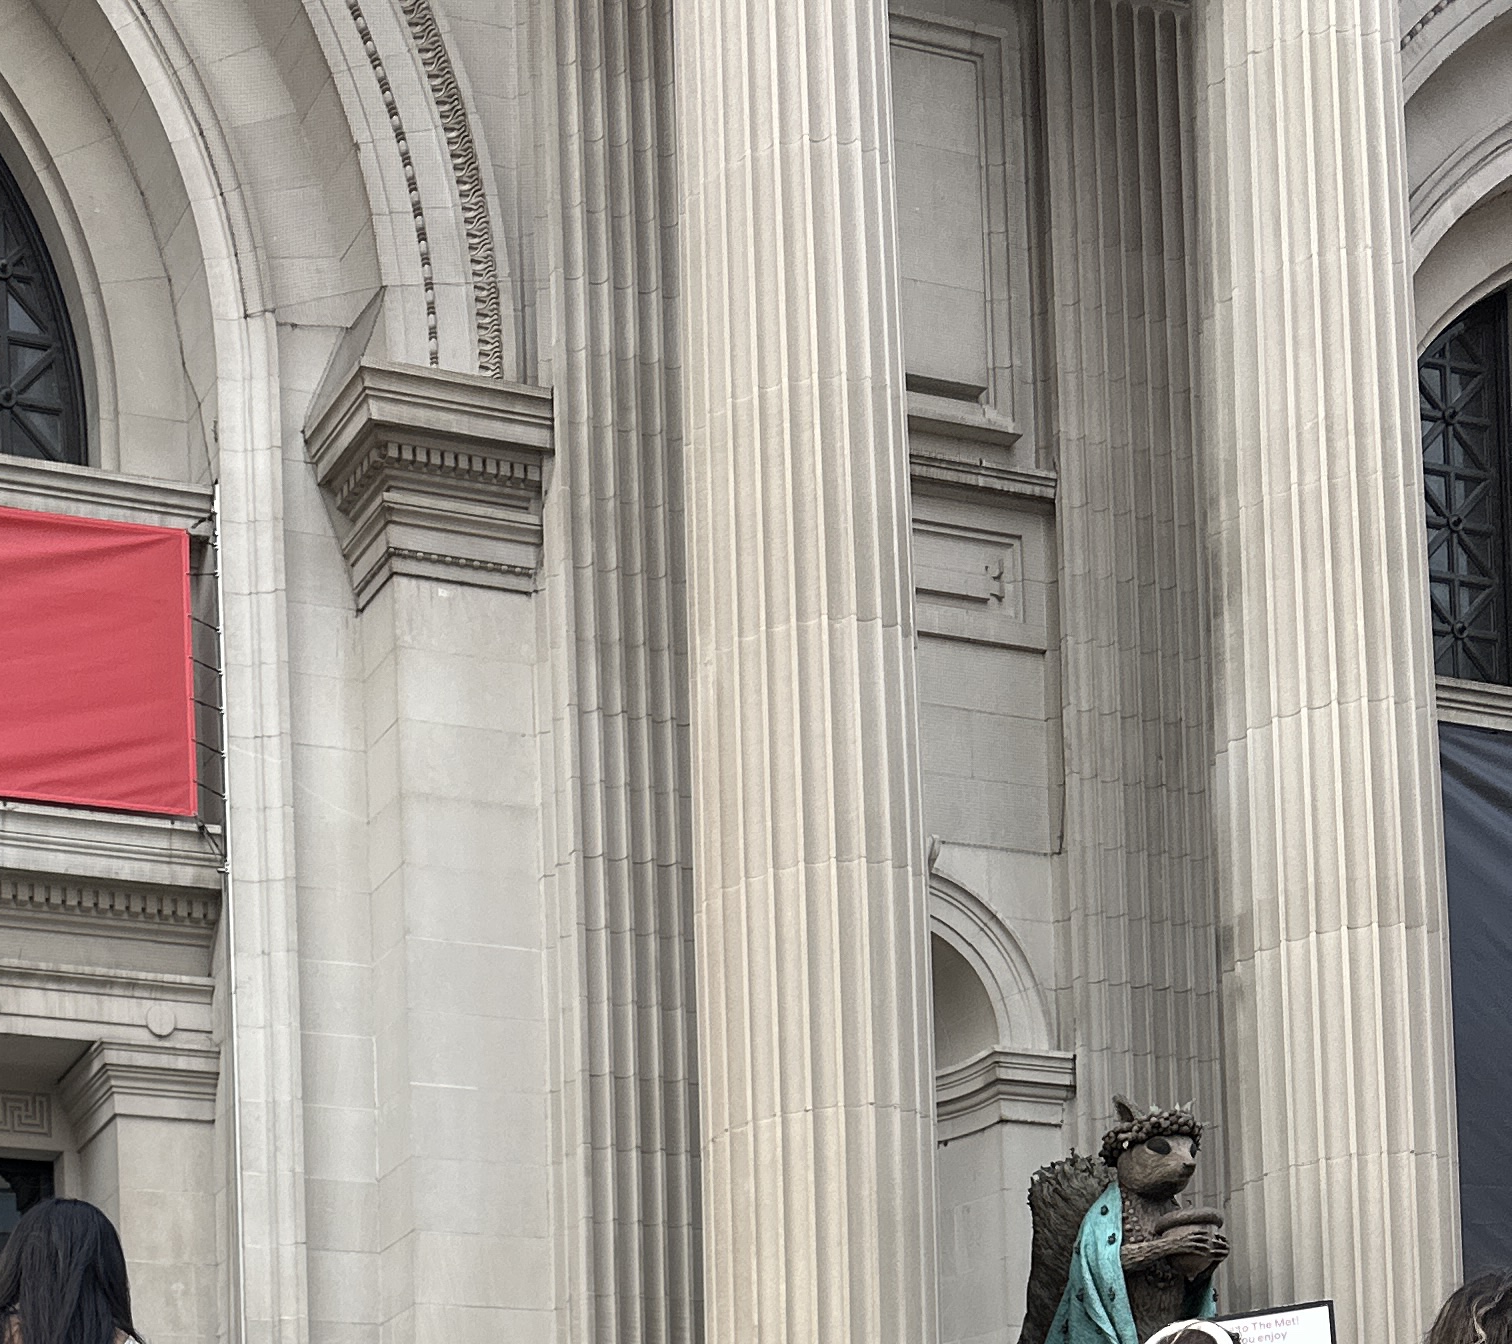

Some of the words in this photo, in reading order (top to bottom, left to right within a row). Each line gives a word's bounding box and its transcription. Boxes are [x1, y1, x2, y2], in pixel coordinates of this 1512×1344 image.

[1251, 1320, 1272, 1332] The
[1274, 1316, 1300, 1328] Met!
[1240, 1335, 1255, 1344] ou
[1257, 1331, 1288, 1343] enjoy
